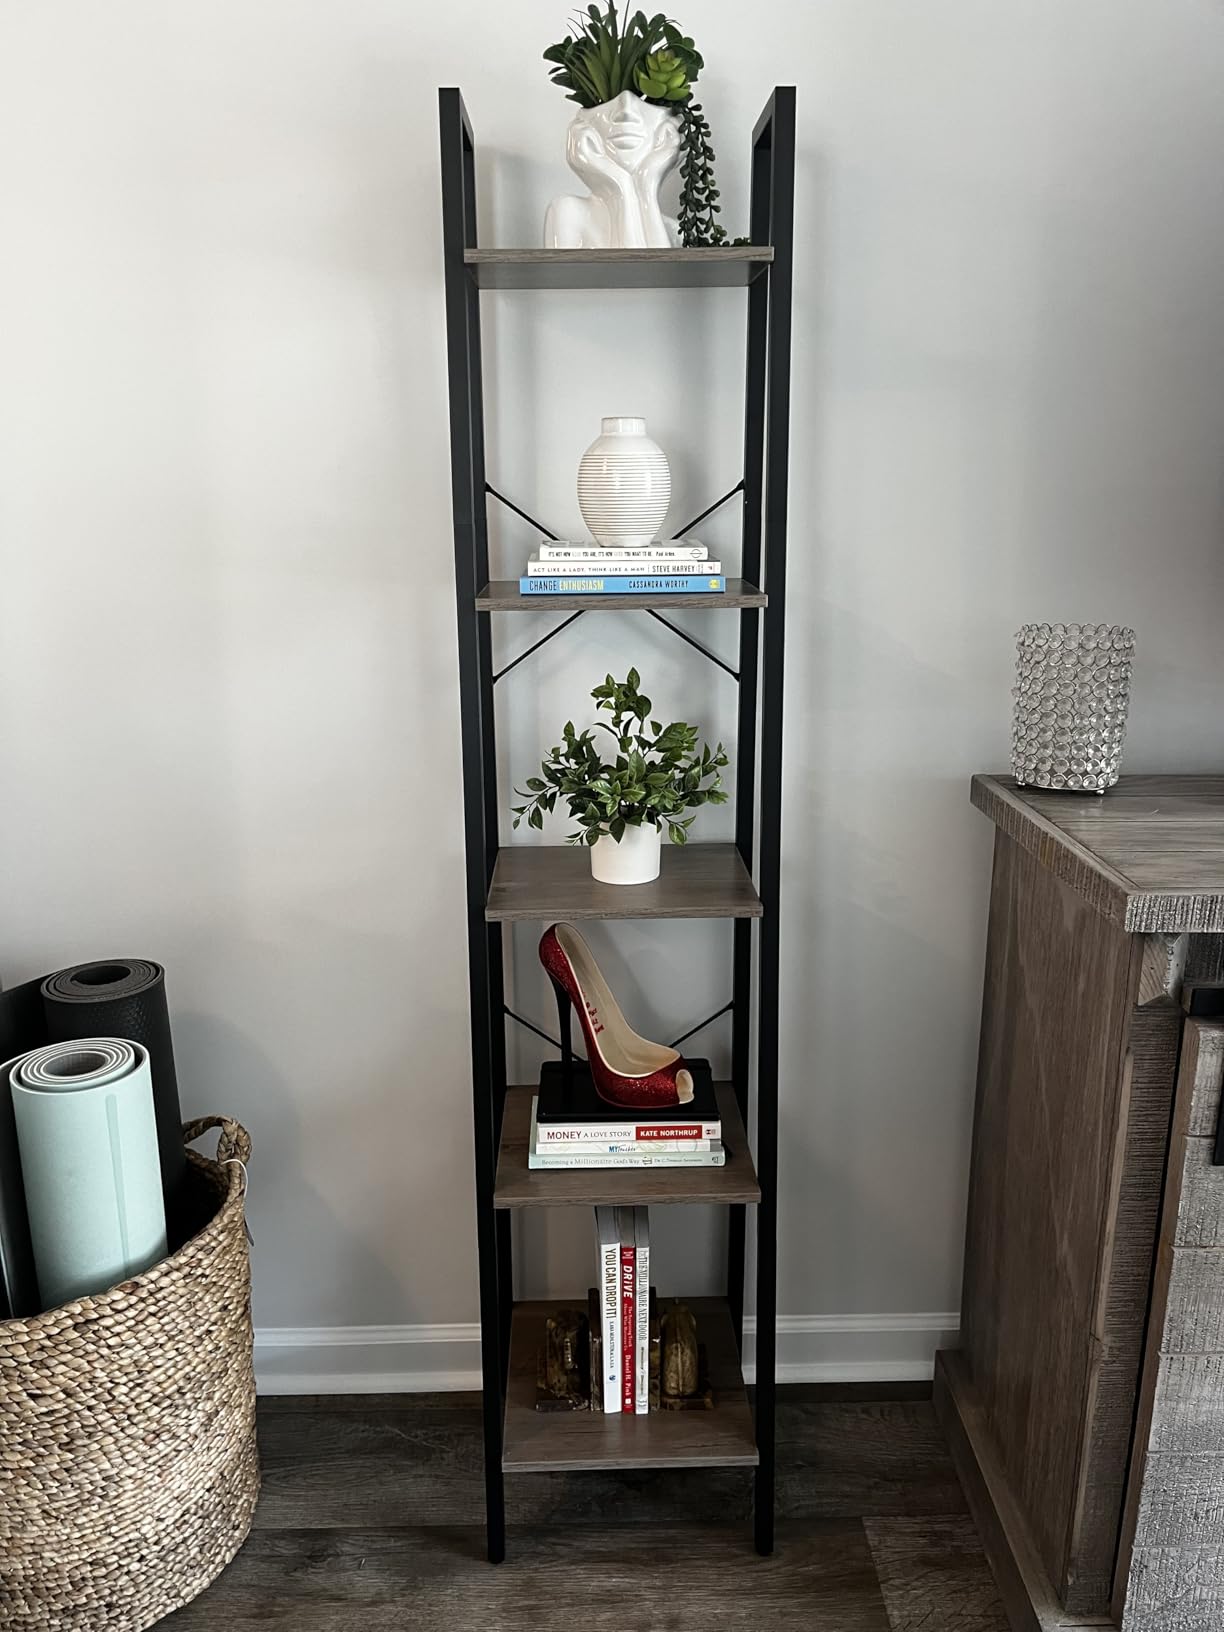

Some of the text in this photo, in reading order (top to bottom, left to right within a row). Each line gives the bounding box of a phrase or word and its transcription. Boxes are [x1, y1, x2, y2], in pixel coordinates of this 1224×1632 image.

[652, 565, 670, 573] STEVE
[672, 565, 695, 573] HARVEY
[529, 579, 604, 591] CHANGE ENTHUSIASM
[628, 580, 688, 588] CASSANDRA WORTHY
[546, 1131, 582, 1140] MONEY
[660, 1129, 698, 1137] NORTHRUP
[605, 1248, 616, 1266] YOU
[605, 1266, 616, 1284] CAN
[605, 1286, 616, 1307] DROP
[638, 1308, 648, 1324] NEXT
[638, 1324, 648, 1340] DOOR
